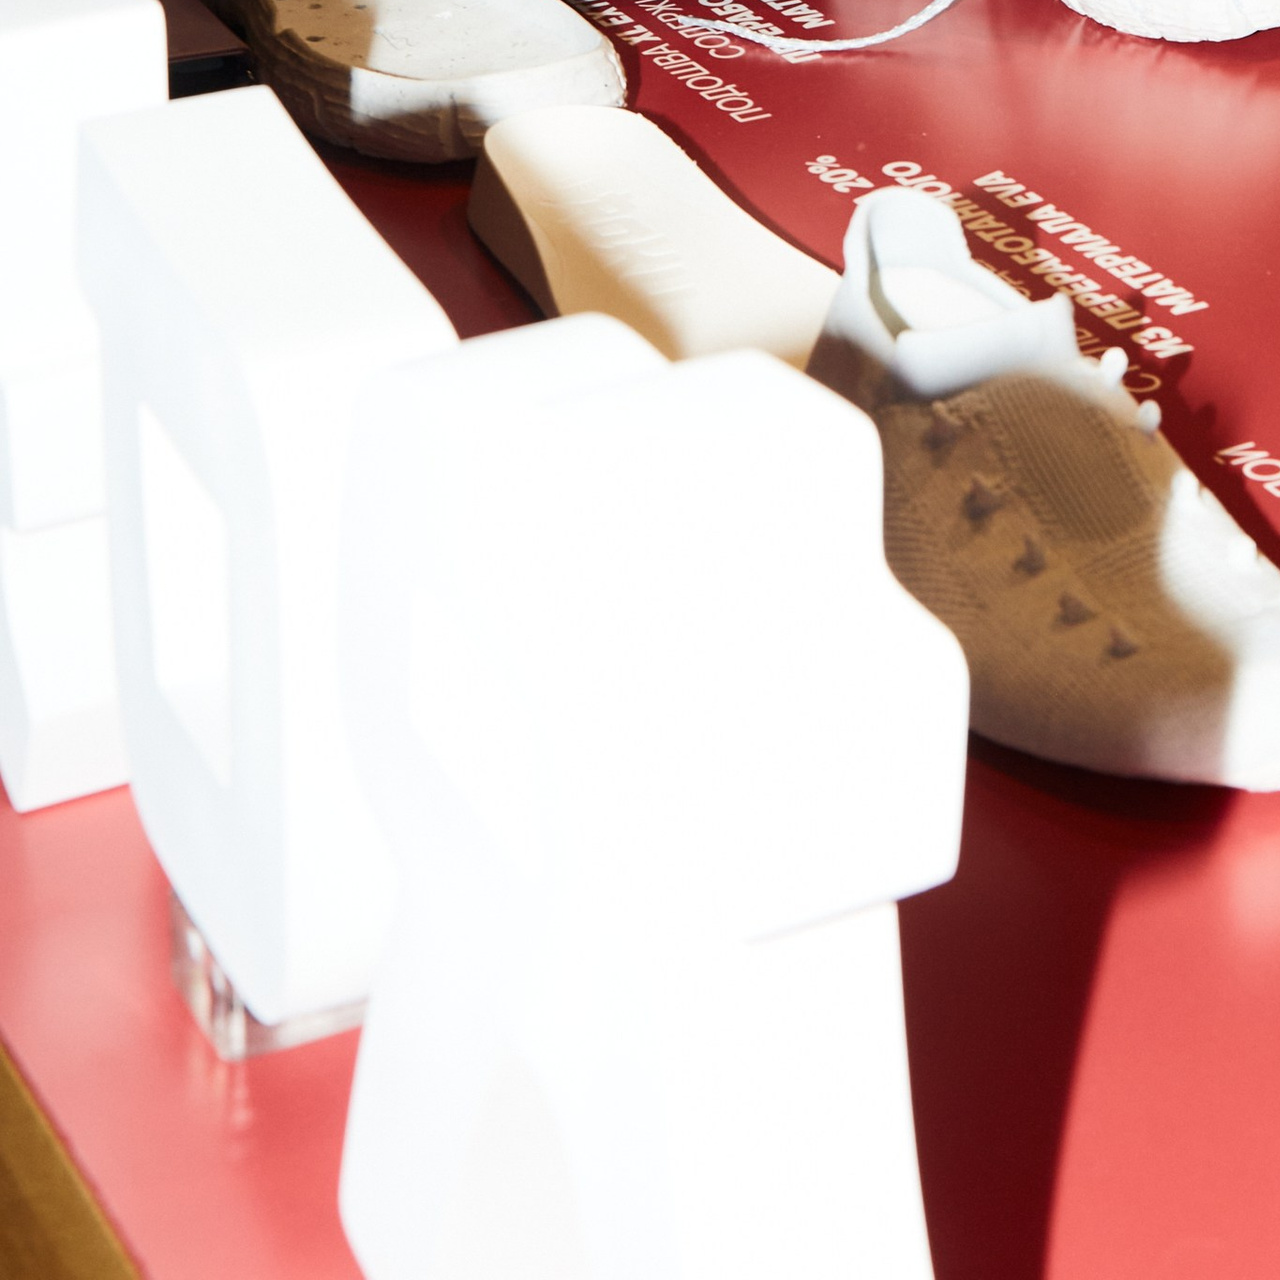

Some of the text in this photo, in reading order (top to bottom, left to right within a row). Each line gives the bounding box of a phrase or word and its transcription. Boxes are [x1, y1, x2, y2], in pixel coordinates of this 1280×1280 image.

[616, 24, 661, 46] XL
[642, 42, 773, 124] ПОДОШВА
[805, 155, 874, 194] 20%
[973, 169, 1041, 208] EVA
[1025, 204, 1210, 316] МАТЕРИАЛА
[1130, 326, 1194, 359] ИЗ
